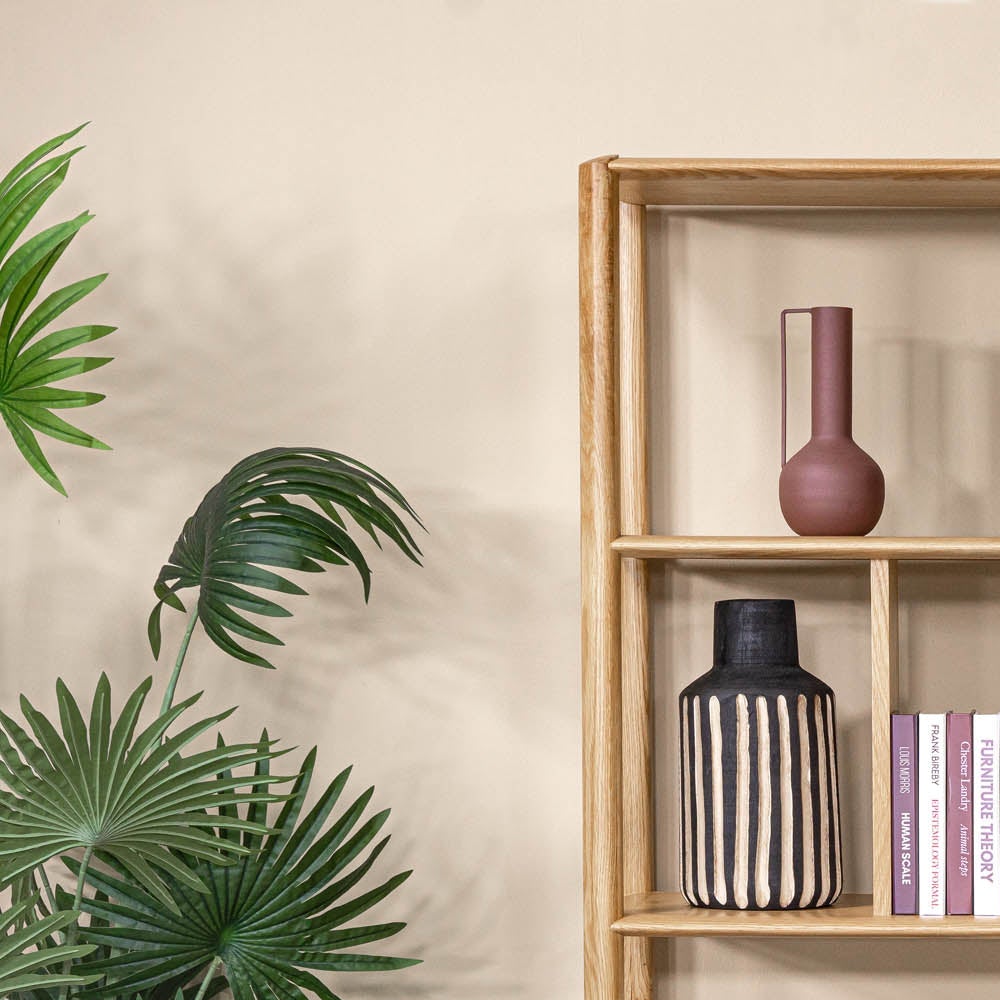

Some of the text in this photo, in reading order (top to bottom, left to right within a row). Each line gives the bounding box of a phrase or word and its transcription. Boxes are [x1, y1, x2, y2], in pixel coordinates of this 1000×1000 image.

[899, 746, 912, 885] LOUIS MORRIS HUMAN SCALE
[931, 725, 939, 909] FRANK BIREBY EPISTEMOLOGY FORMAL
[958, 741, 971, 877] Chester Landry Animal steps
[980, 739, 994, 884] FURNITURE THEORY
